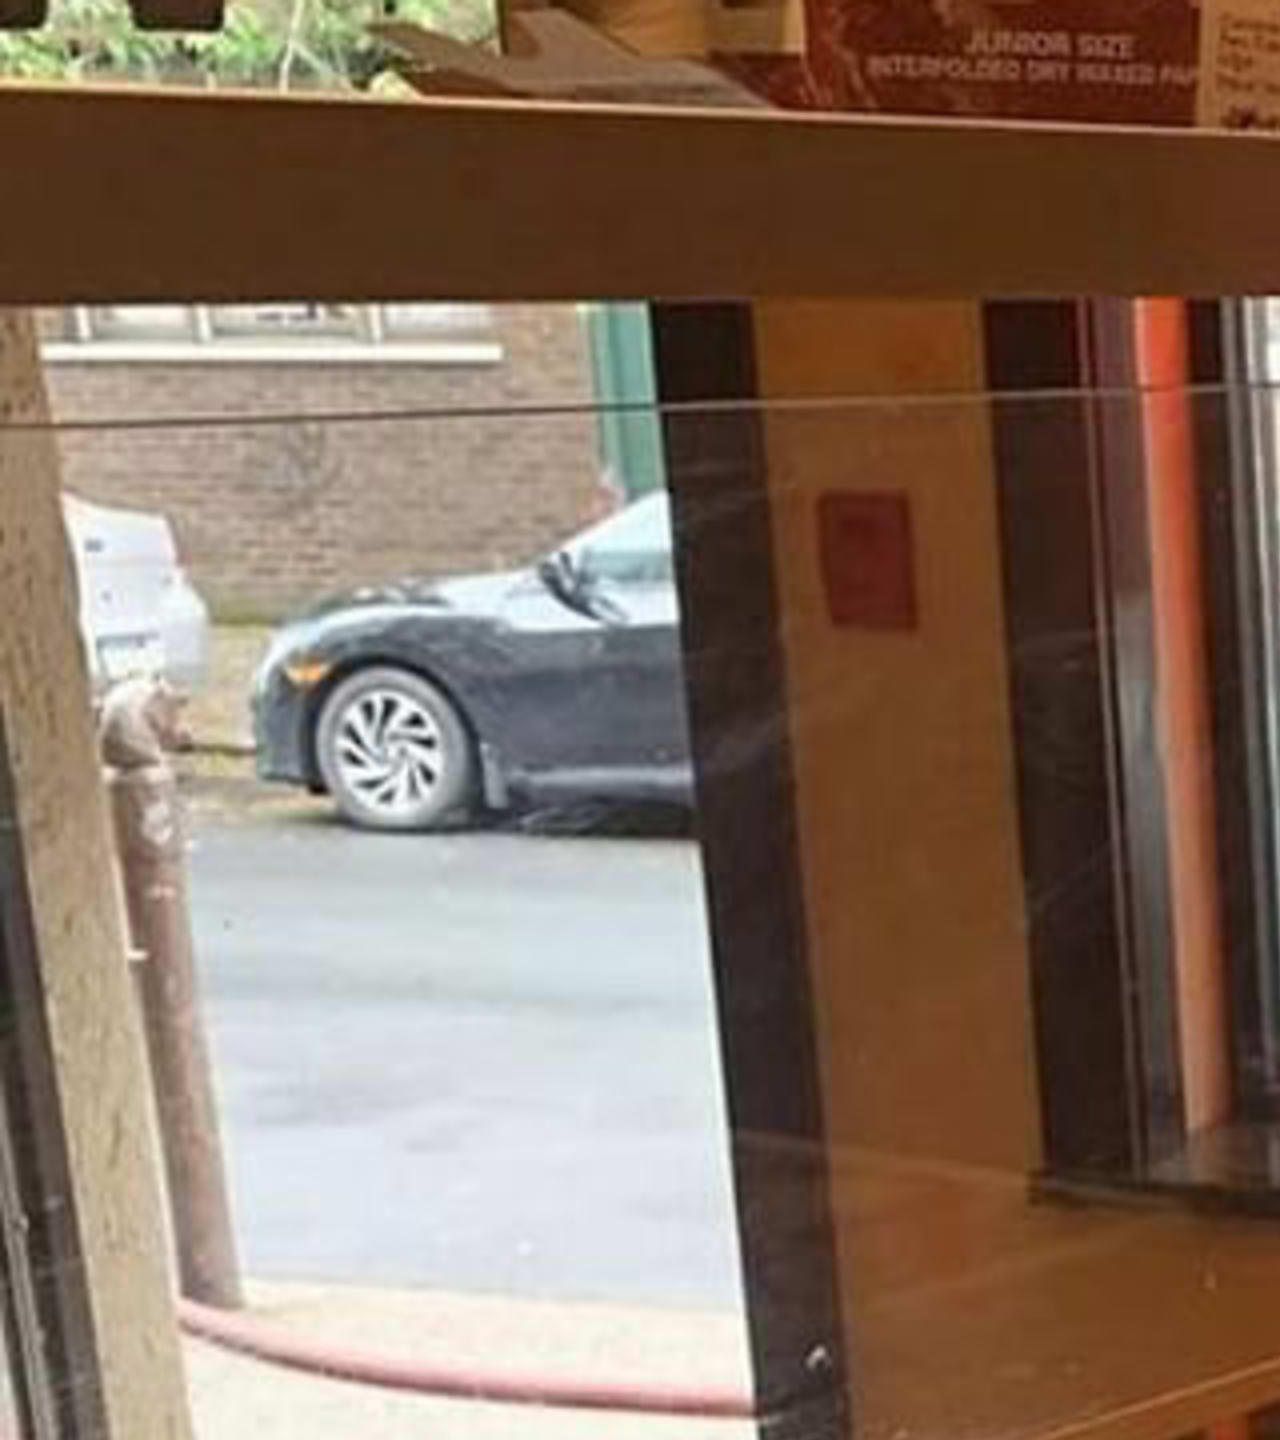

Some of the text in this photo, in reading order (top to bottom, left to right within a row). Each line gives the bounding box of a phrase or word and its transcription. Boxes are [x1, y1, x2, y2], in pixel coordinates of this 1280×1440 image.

[964, 29, 1137, 59] JUNIOR SIZE
[866, 54, 1021, 82] INTERFOLDED
[1026, 59, 1070, 83] DRY
[1075, 62, 1154, 85] WAXED
